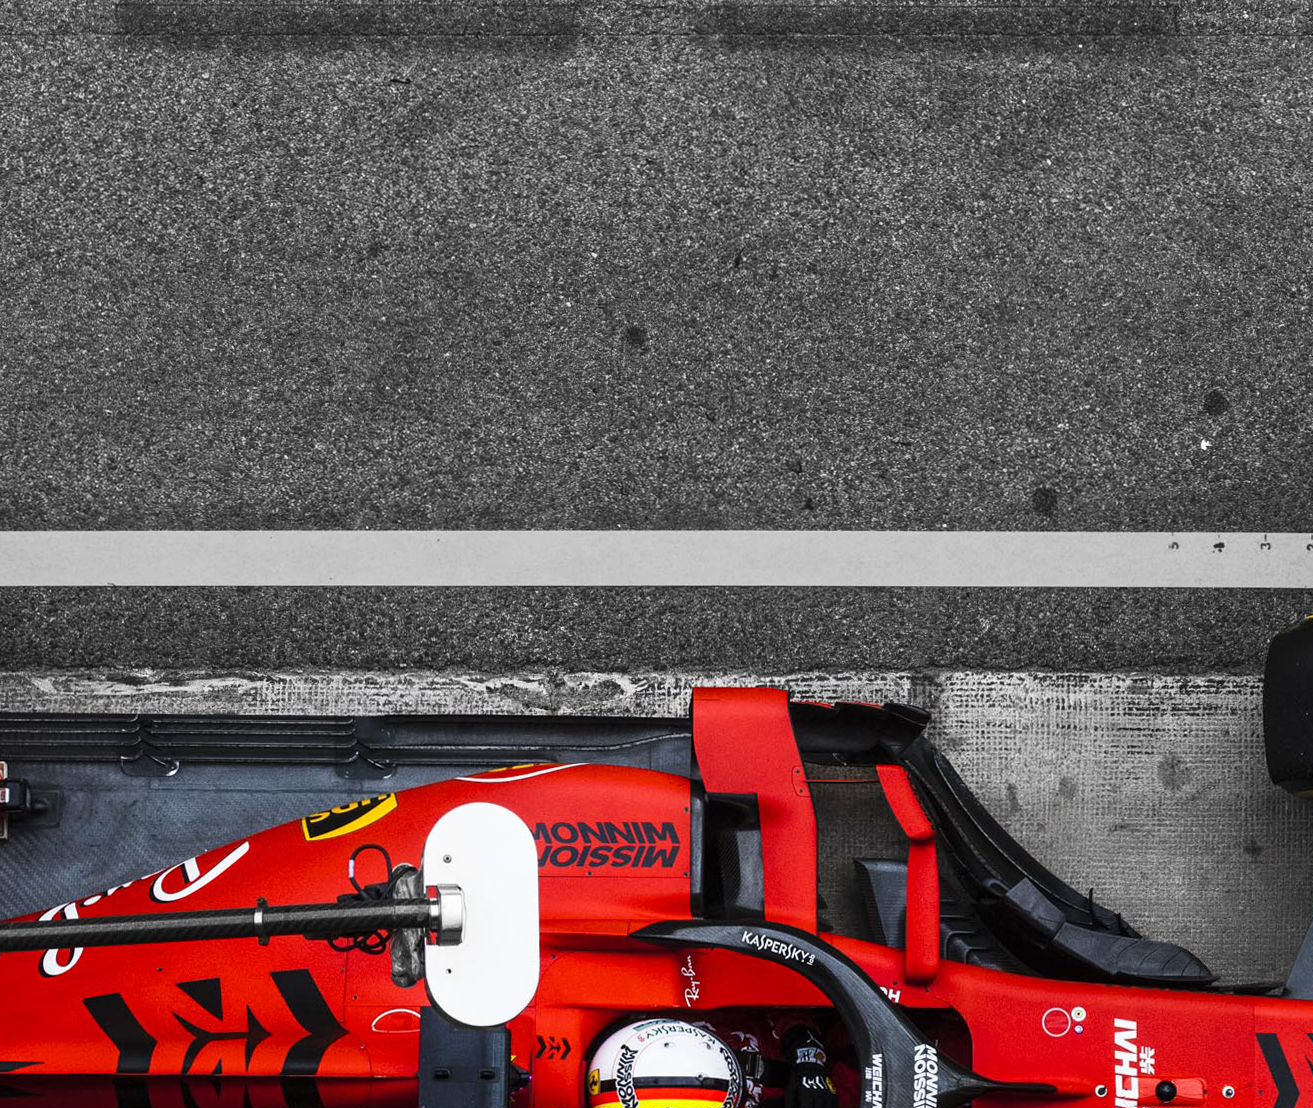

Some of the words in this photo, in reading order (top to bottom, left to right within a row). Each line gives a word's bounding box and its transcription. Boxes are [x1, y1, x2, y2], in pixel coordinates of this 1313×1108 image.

[741, 931, 809, 963] KASPERSKY
[681, 955, 700, 1007] Ray-Ban
[645, 1025, 716, 1045] KASPERSKY
